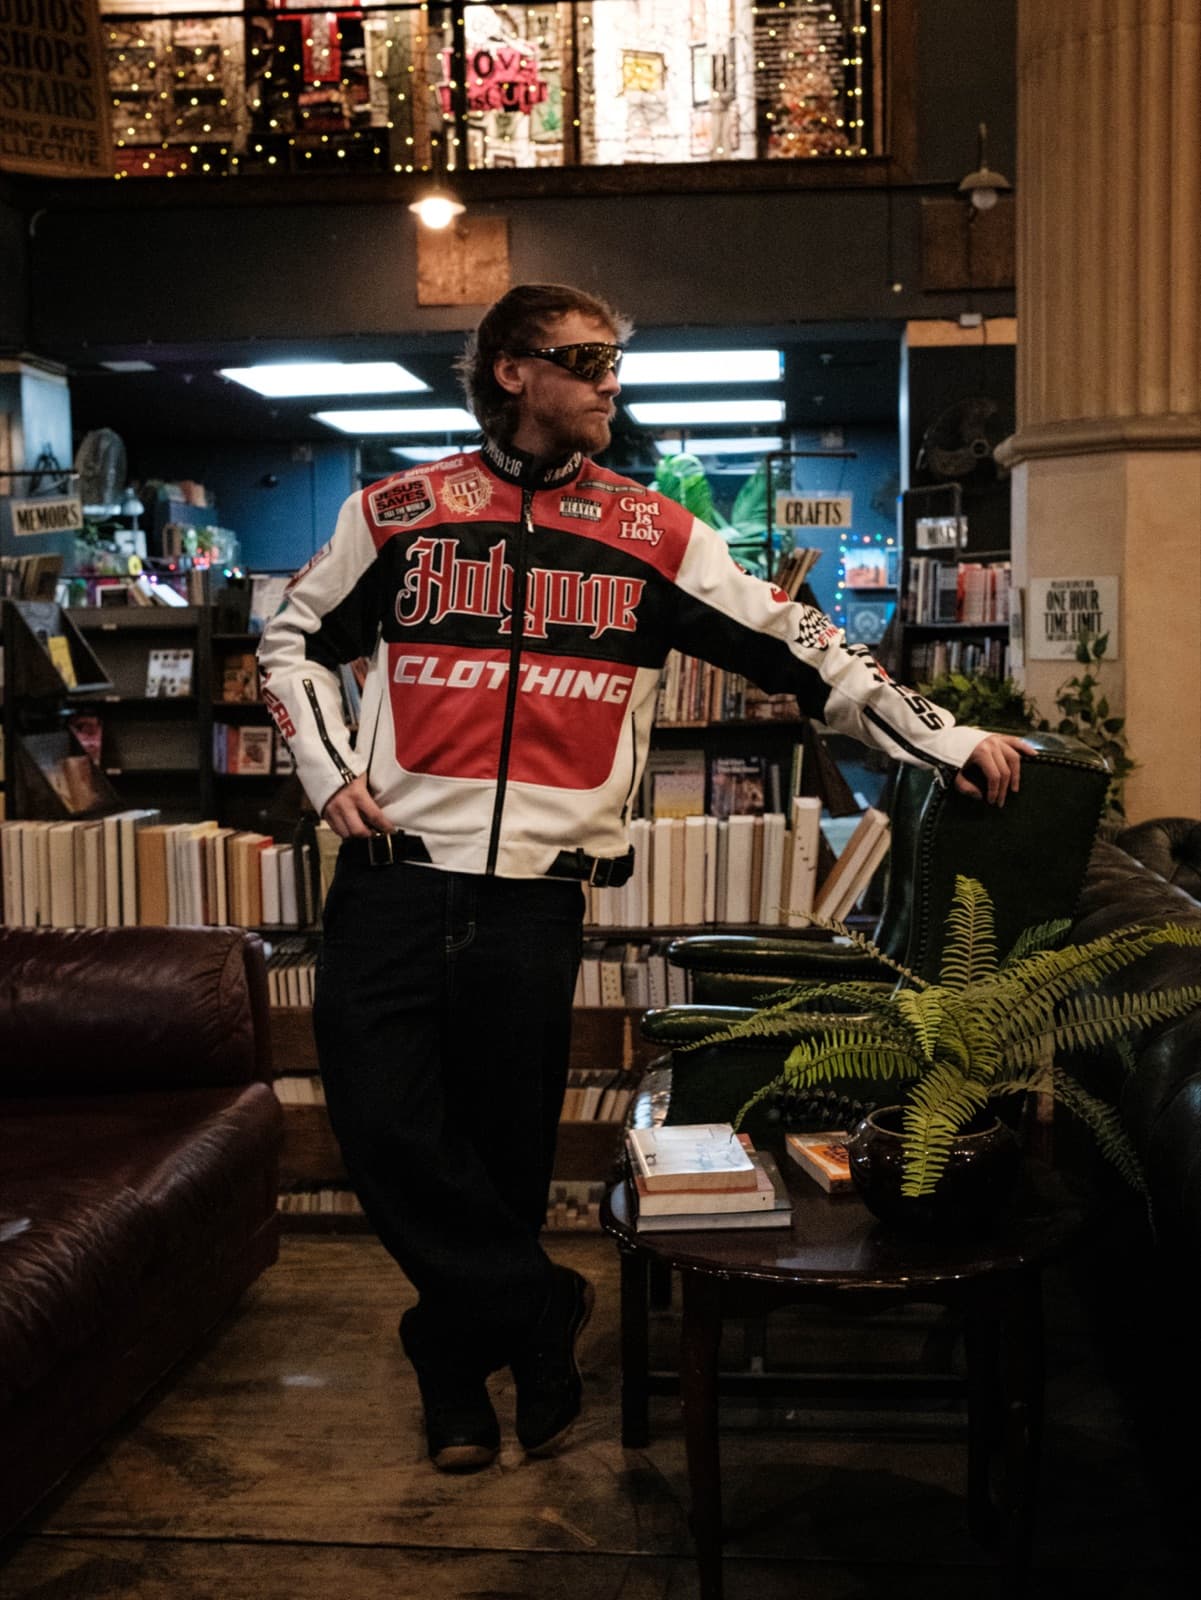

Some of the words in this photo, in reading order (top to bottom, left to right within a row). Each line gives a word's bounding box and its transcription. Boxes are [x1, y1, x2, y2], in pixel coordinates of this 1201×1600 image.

[375, 480, 423, 502] JESUS
[376, 489, 427, 511] SAVES
[620, 496, 661, 516] God
[785, 501, 842, 525] CRAFTS
[17, 504, 79, 531] MEMOIRS
[619, 521, 664, 547] Holy
[1046, 590, 1066, 611] ONE
[1069, 590, 1099, 611] HOUR
[1044, 612, 1068, 633] TIME
[1071, 612, 1103, 633] LIMIT
[393, 655, 633, 704] CLOTHING
